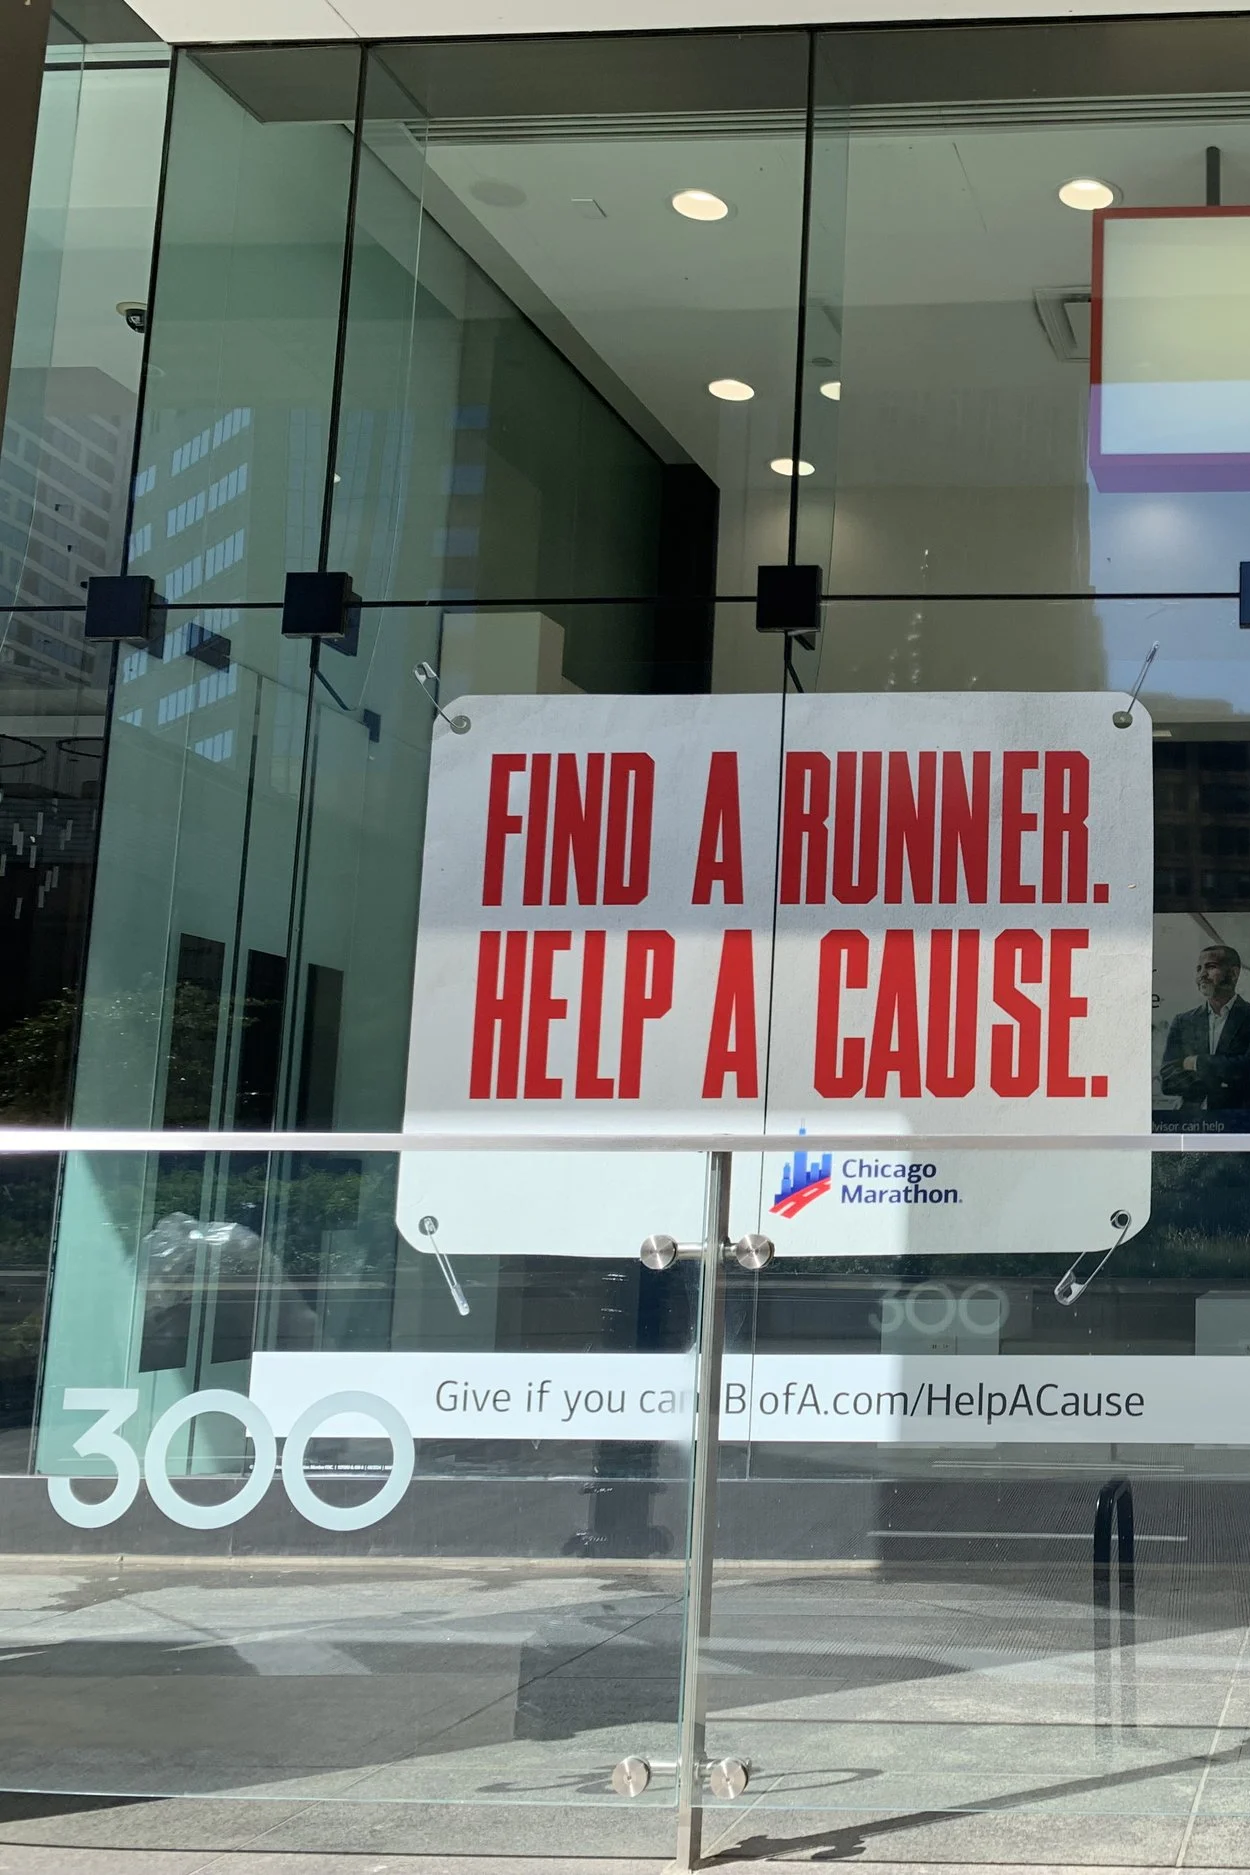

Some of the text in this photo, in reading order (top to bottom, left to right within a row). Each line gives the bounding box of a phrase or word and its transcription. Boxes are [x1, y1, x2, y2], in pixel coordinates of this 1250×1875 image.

[482, 751, 1109, 906] FIND A RUNNER.
[469, 929, 1109, 1100] HELP A CAUSE.
[842, 1159, 937, 1183] Chicago
[1181, 1123, 1200, 1131] can
[1202, 1121, 1225, 1132] help
[435, 1379, 512, 1413] Give
[525, 1379, 551, 1413] if
[563, 1389, 625, 1422] you
[47, 1387, 416, 1531] 300
